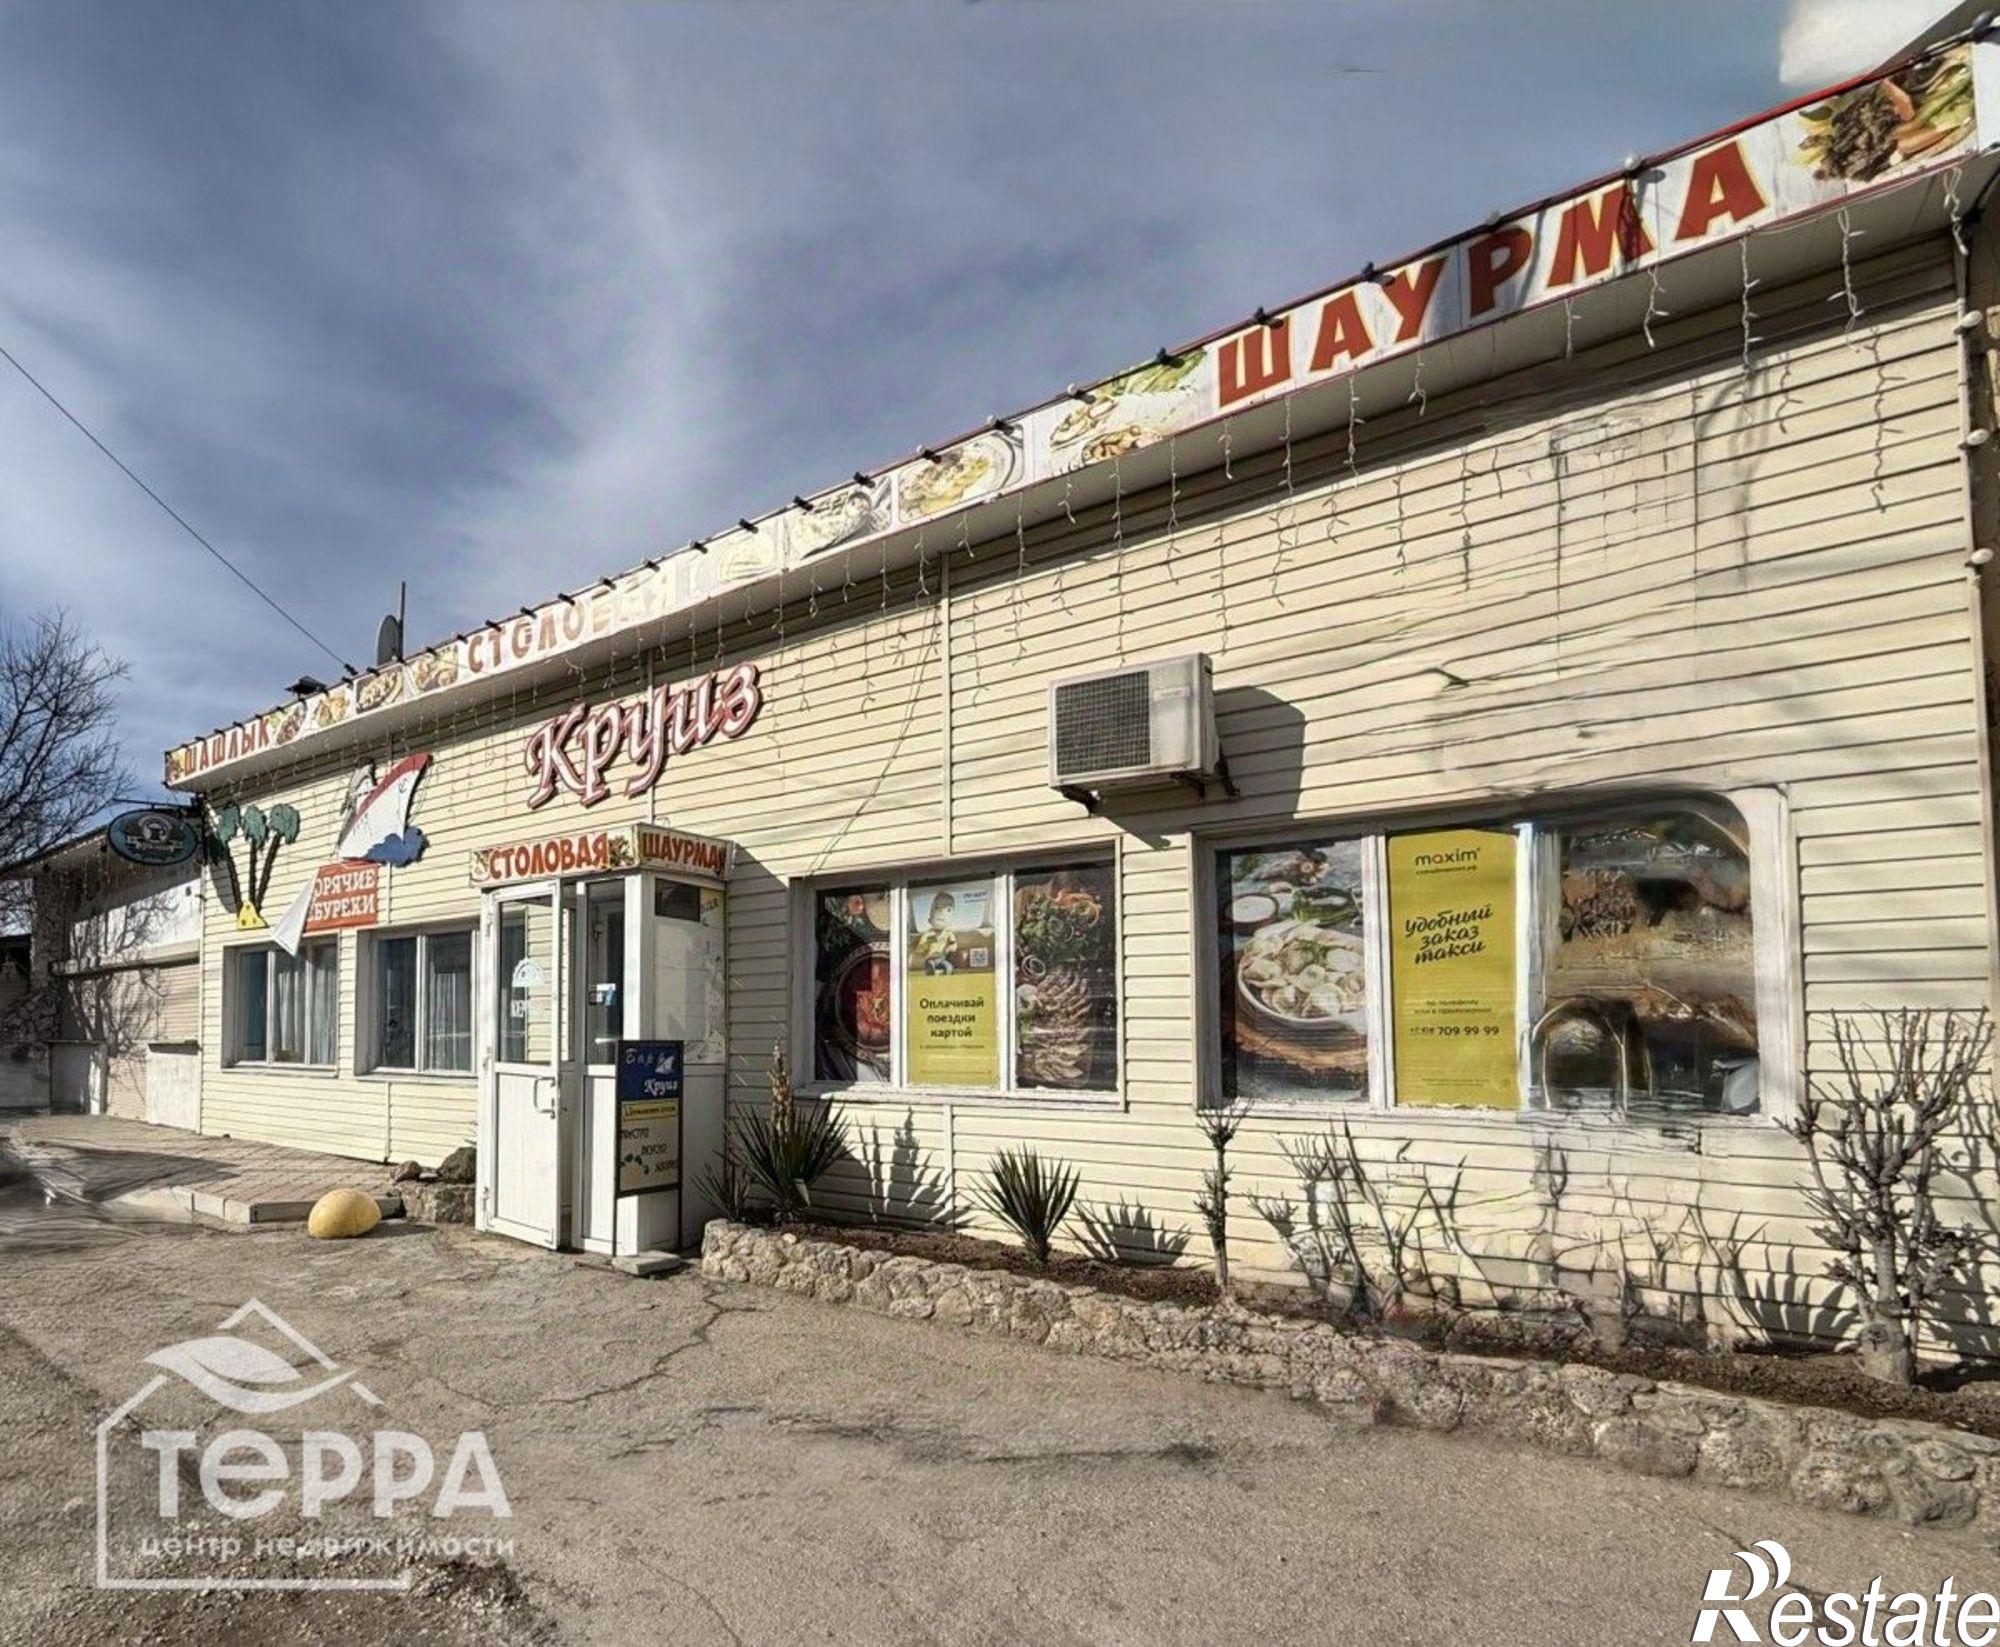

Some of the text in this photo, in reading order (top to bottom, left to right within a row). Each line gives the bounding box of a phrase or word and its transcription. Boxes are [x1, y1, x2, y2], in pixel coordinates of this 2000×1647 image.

[1216, 138, 1768, 407] ШАУРМА
[185, 717, 269, 776] ШАШЛЫК
[524, 661, 760, 809] Круиз
[489, 832, 609, 880] СТОЛОВАЯ
[642, 832, 721, 870] ШАУРМА
[1414, 847, 1478, 866] maxim
[313, 868, 376, 898] ОРЯЧИЕ
[309, 893, 376, 921] БУРЕКИ
[1420, 925, 1479, 951] заказ
[1415, 941, 1486, 964] такси
[919, 996, 984, 1009] Оплачивай
[926, 1014, 976, 1025] поездки
[930, 1026, 973, 1040] картой
[1437, 1026, 1460, 1036] 709
[1464, 1026, 1479, 1036] 99
[1483, 1026, 1499, 1036] 99
